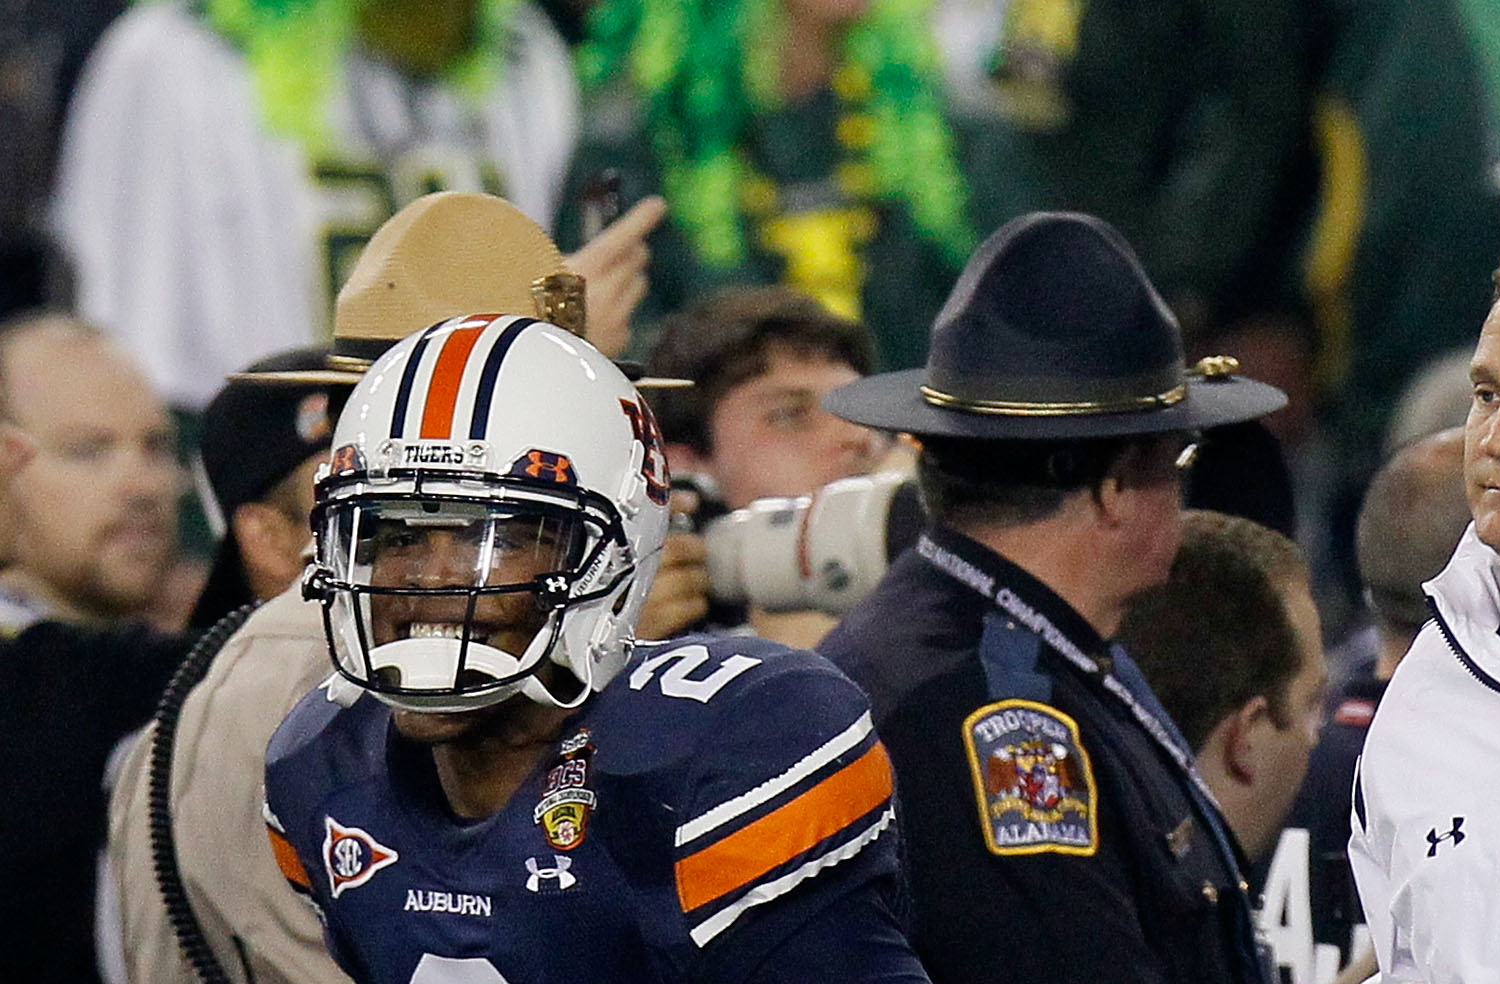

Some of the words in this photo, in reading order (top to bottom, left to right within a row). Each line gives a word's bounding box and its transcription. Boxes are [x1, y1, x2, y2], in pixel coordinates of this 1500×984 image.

[404, 446, 464, 464] TIGERS
[630, 645, 763, 703] 2
[334, 837, 363, 877] SEC
[404, 889, 492, 917] AUBURN
